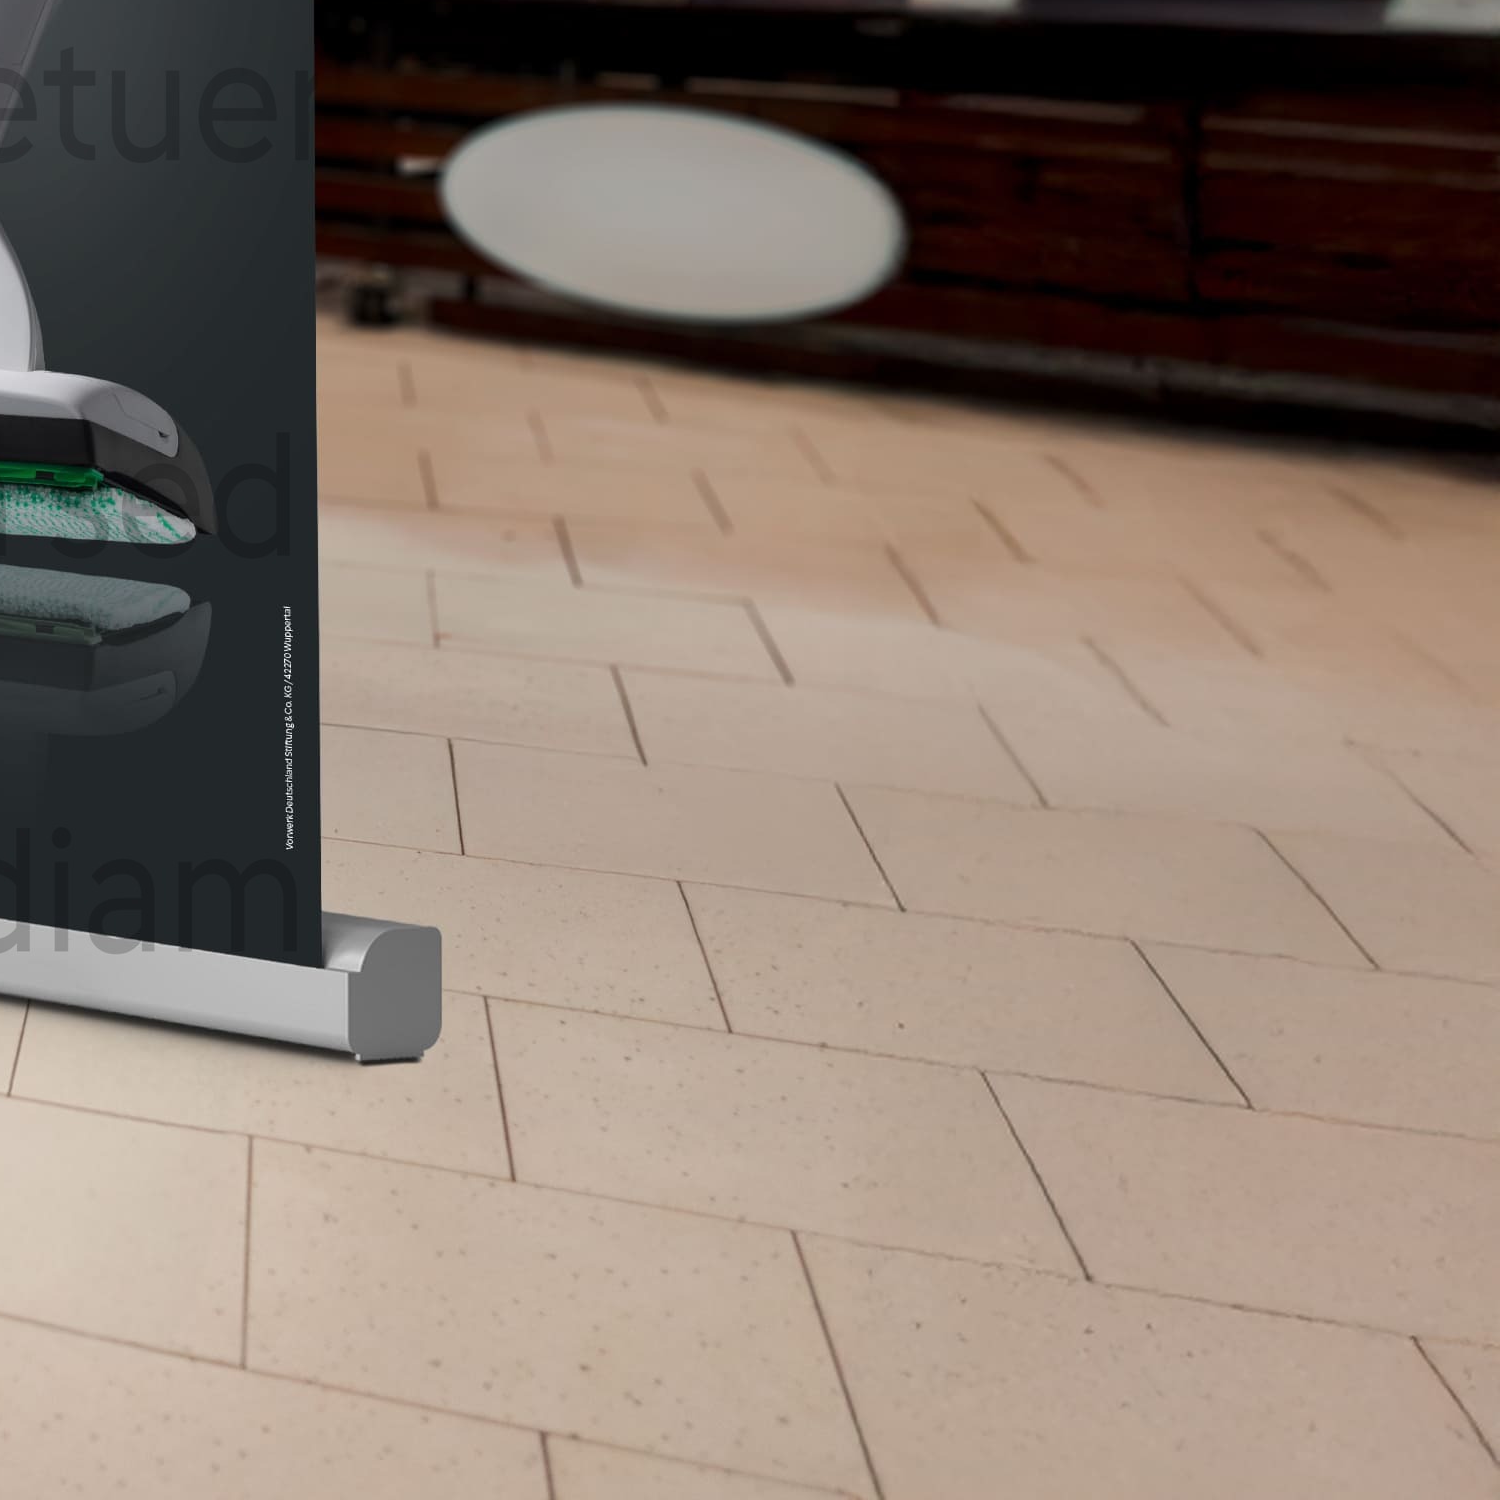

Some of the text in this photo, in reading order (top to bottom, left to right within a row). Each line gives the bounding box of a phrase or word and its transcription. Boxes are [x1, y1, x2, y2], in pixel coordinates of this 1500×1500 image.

[284, 723, 295, 757] Stiftung
[285, 758, 294, 814] Deutschland
[285, 814, 294, 850] Vorwerk
